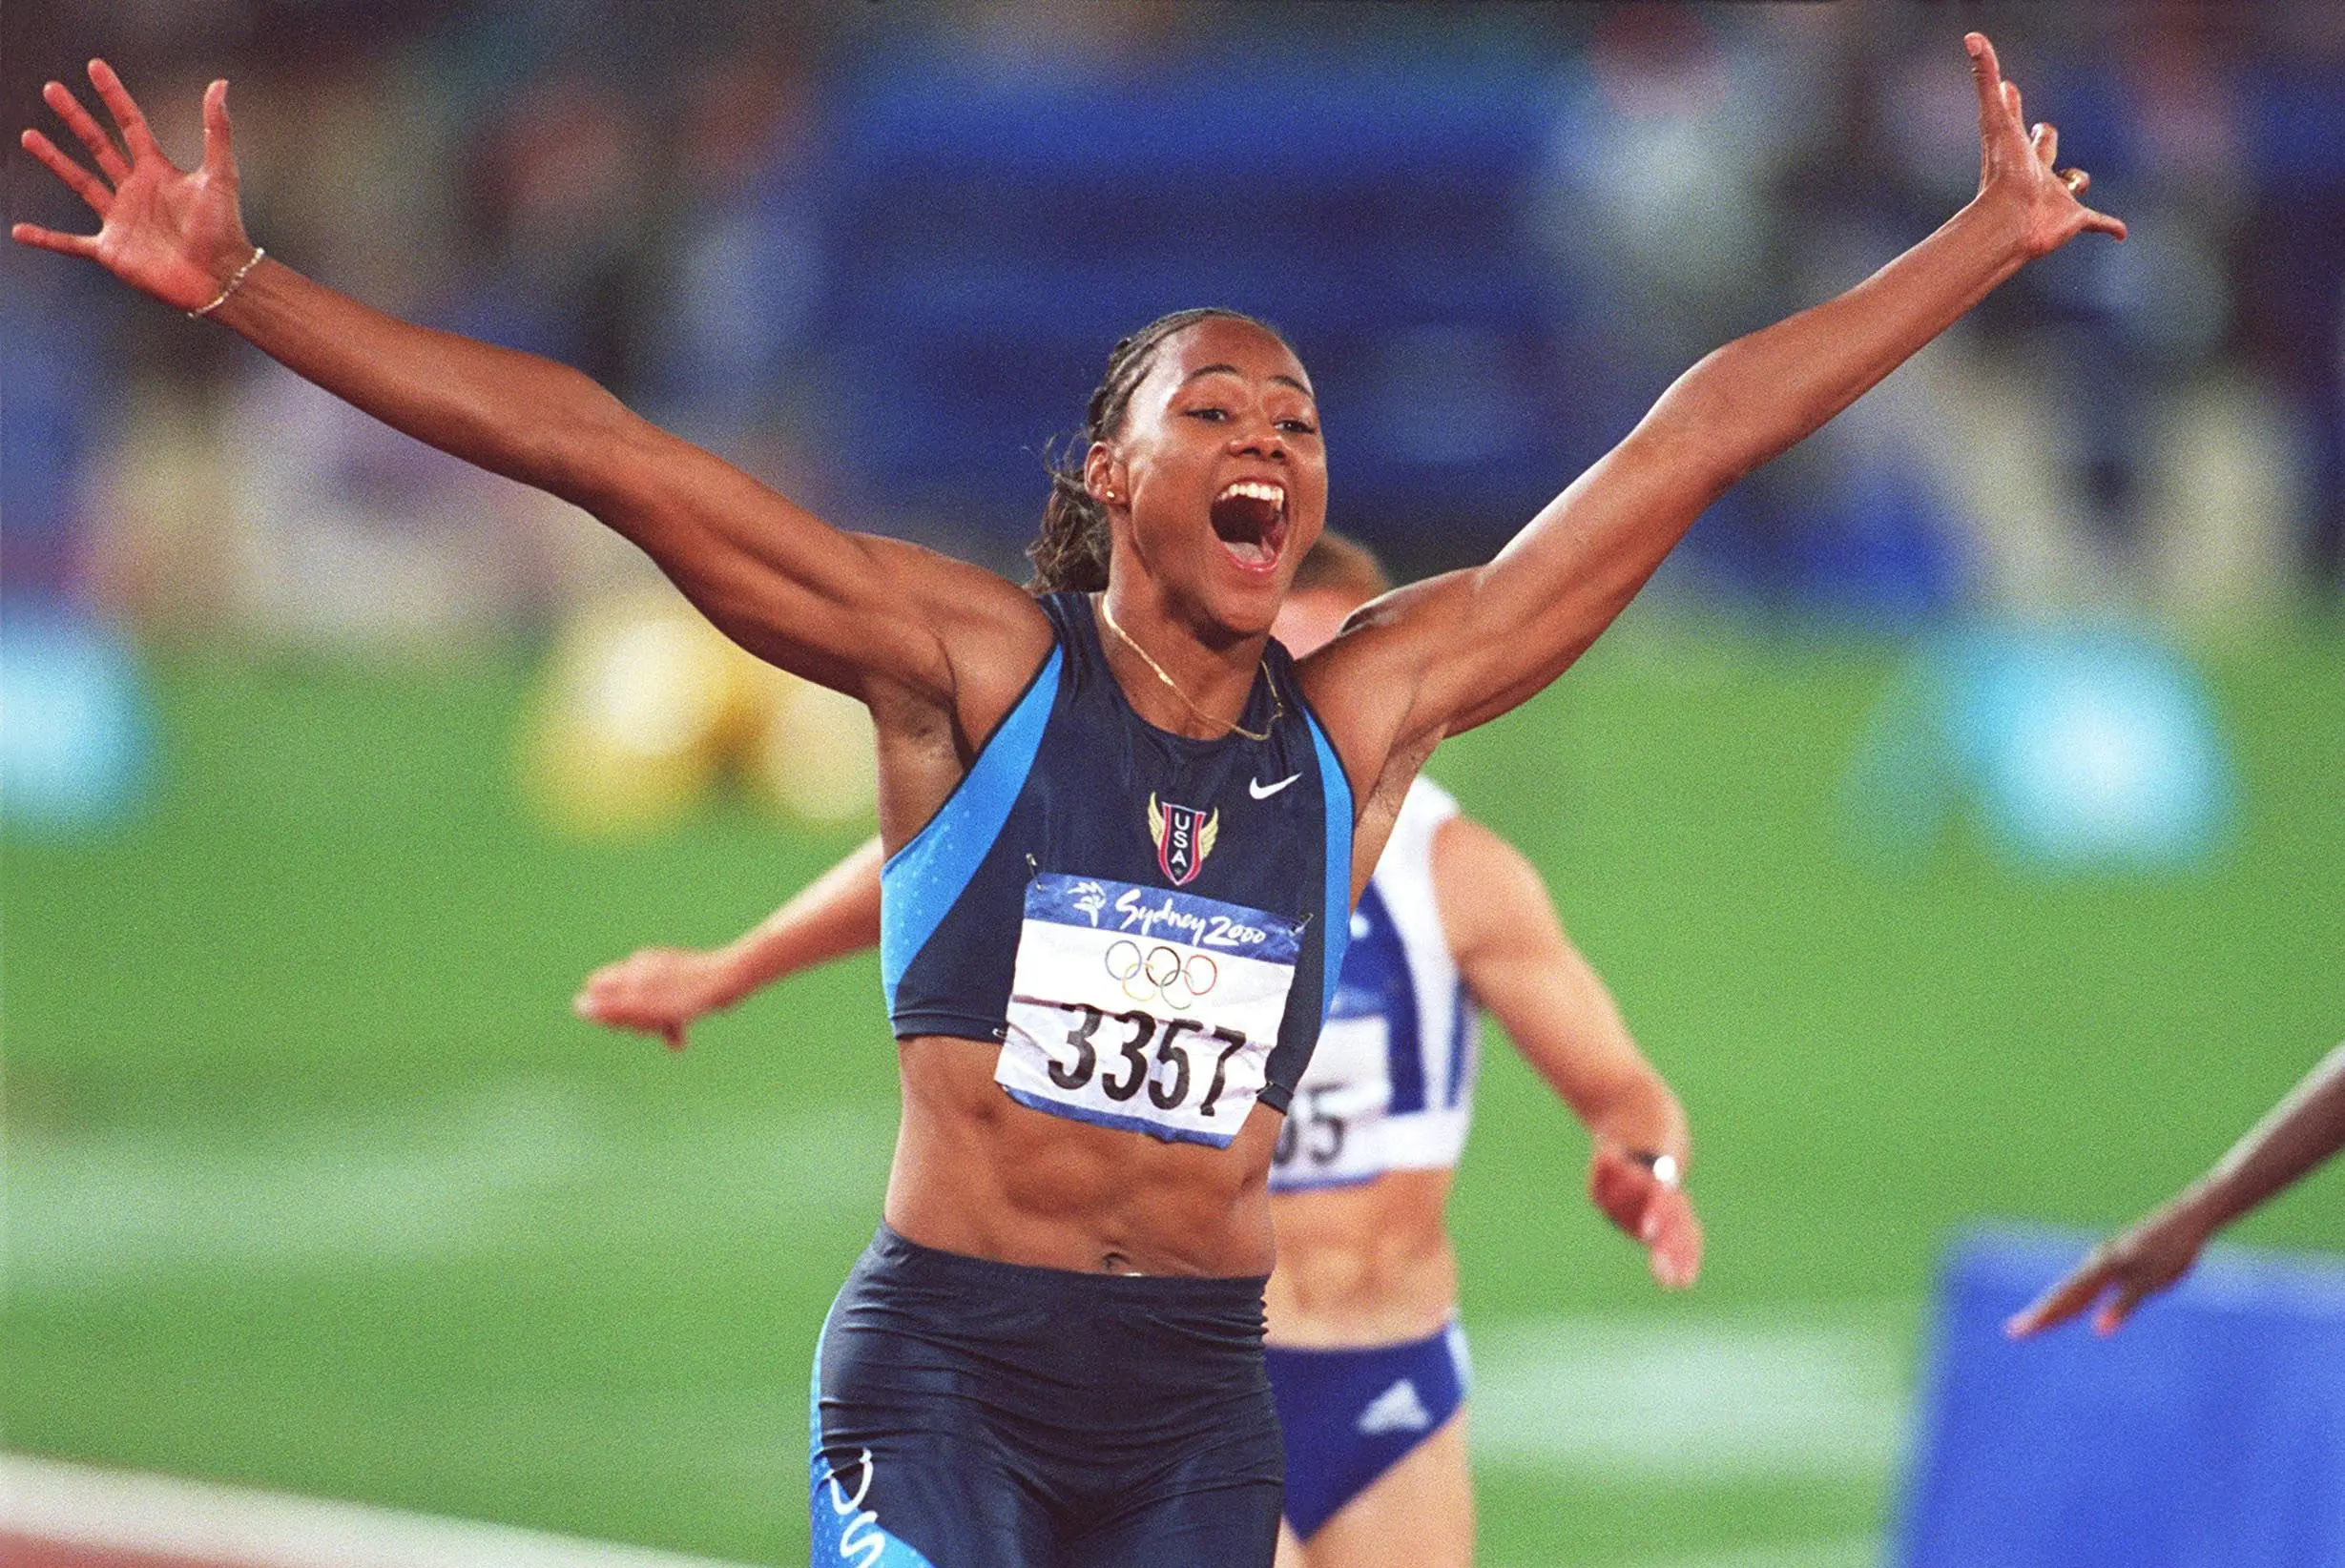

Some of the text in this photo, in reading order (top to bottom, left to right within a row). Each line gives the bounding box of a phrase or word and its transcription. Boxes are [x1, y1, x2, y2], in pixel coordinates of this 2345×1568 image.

[1171, 813, 1191, 867] USA
[1115, 888, 1266, 947] Sydney 2000
[1048, 1003, 1246, 1117] 3357
